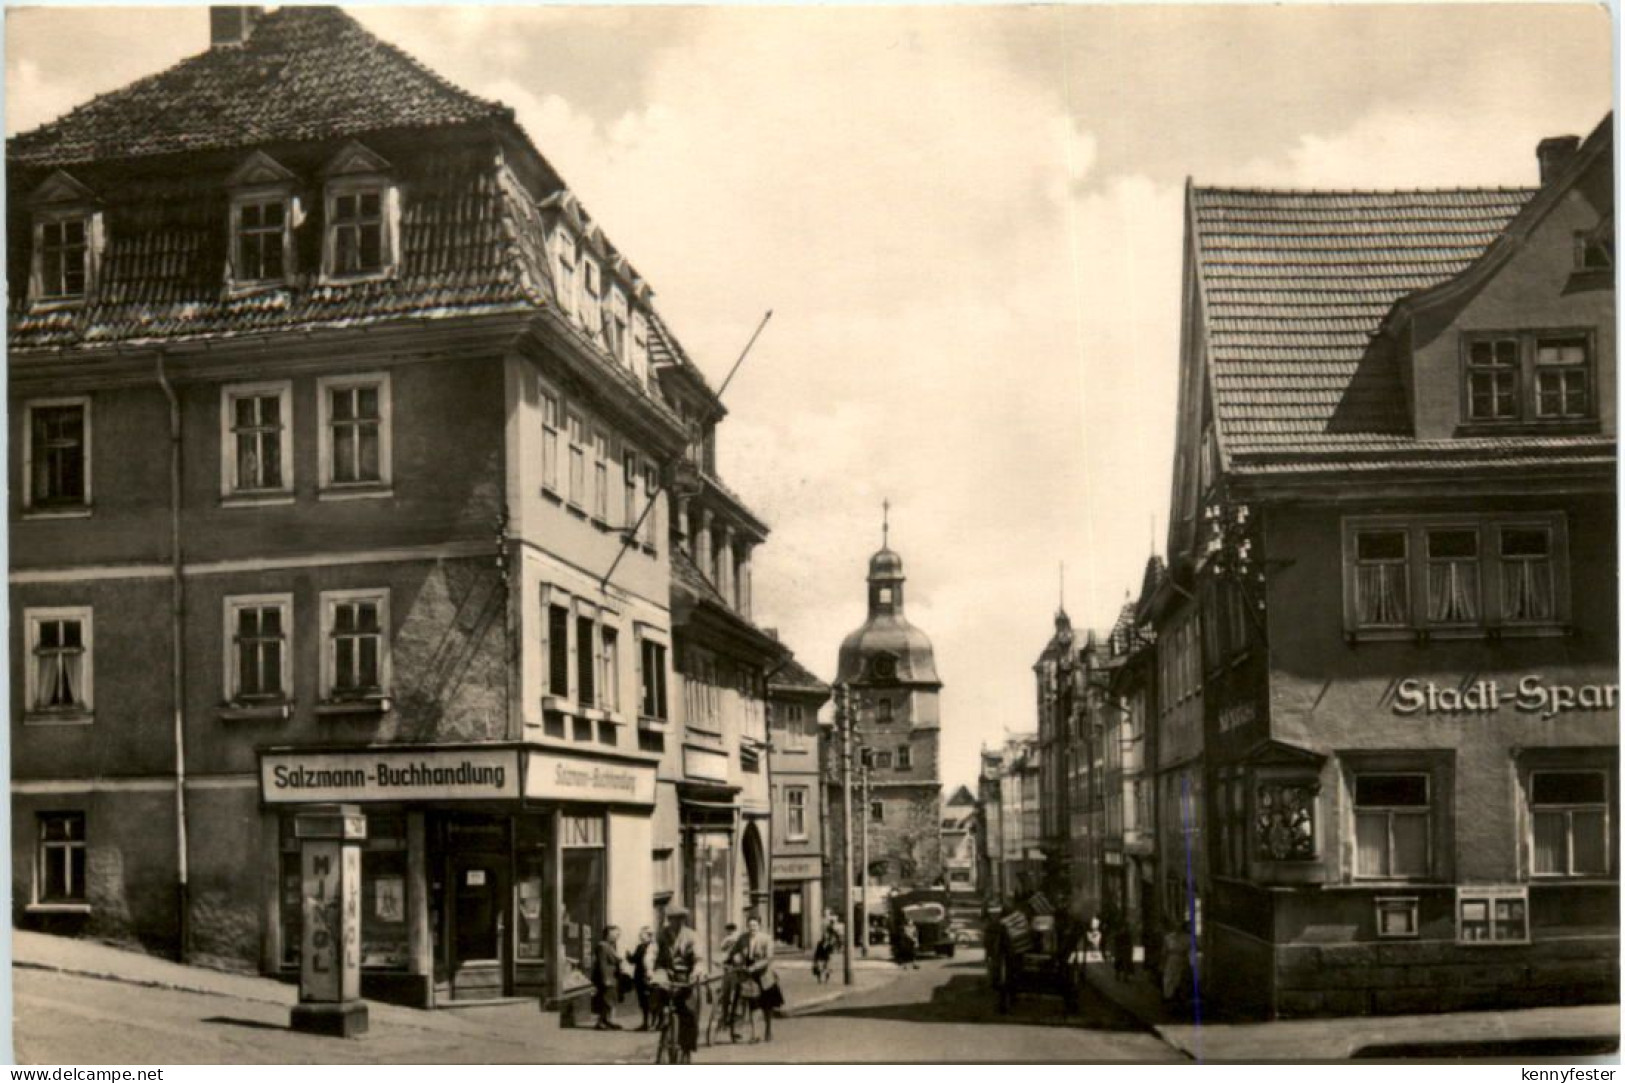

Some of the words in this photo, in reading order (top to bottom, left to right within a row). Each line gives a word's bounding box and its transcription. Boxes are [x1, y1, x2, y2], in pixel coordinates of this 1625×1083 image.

[1393, 674, 1619, 720] Stadt-Spar
[273, 760, 506, 789] Salzmann-Buchhandlung
[312, 854, 331, 974] MINOL
